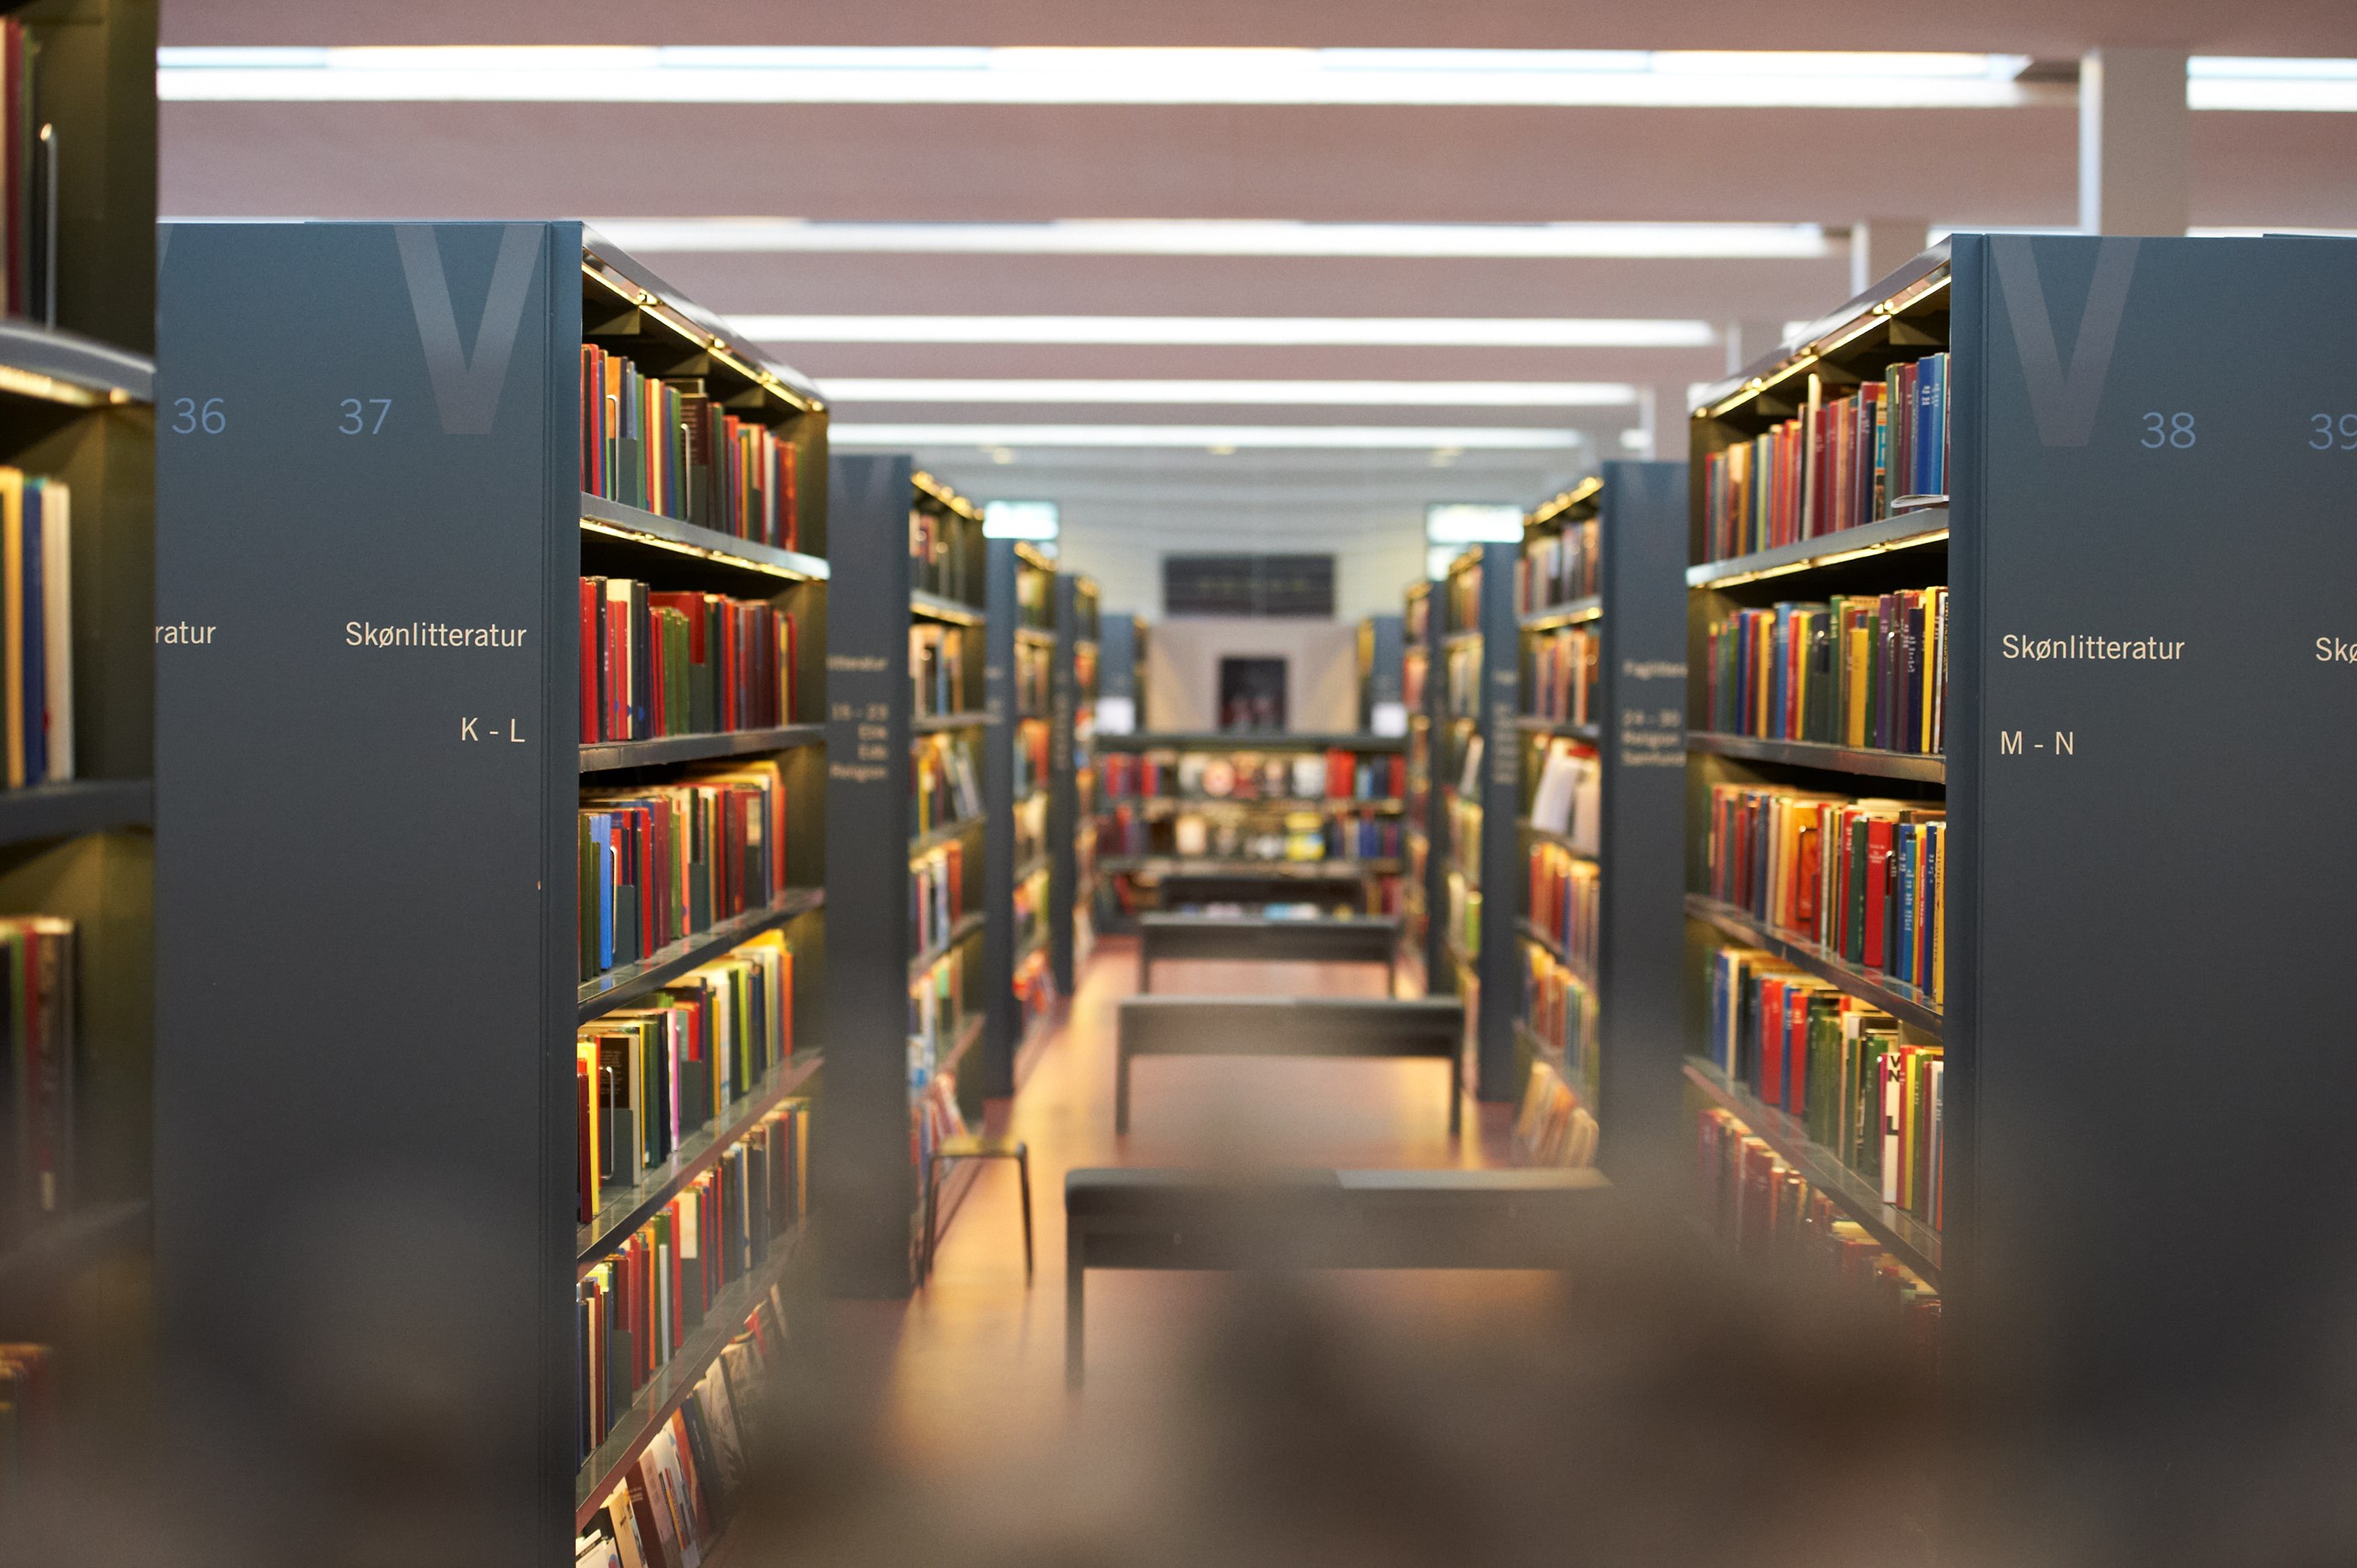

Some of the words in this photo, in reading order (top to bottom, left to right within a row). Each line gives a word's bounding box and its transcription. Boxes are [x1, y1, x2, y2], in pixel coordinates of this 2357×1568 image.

[172, 396, 227, 435] 36
[338, 396, 393, 436] 37
[2140, 411, 2196, 449] 38
[2308, 413, 2357, 450] 39
[155, 620, 216, 645] ratur
[345, 621, 527, 649] Skønlitteratur
[2002, 634, 2185, 662] Skønlitteratur
[461, 716, 479, 741] K
[510, 718, 526, 743] L
[2001, 731, 2023, 756] M
[2056, 731, 2074, 757] N
